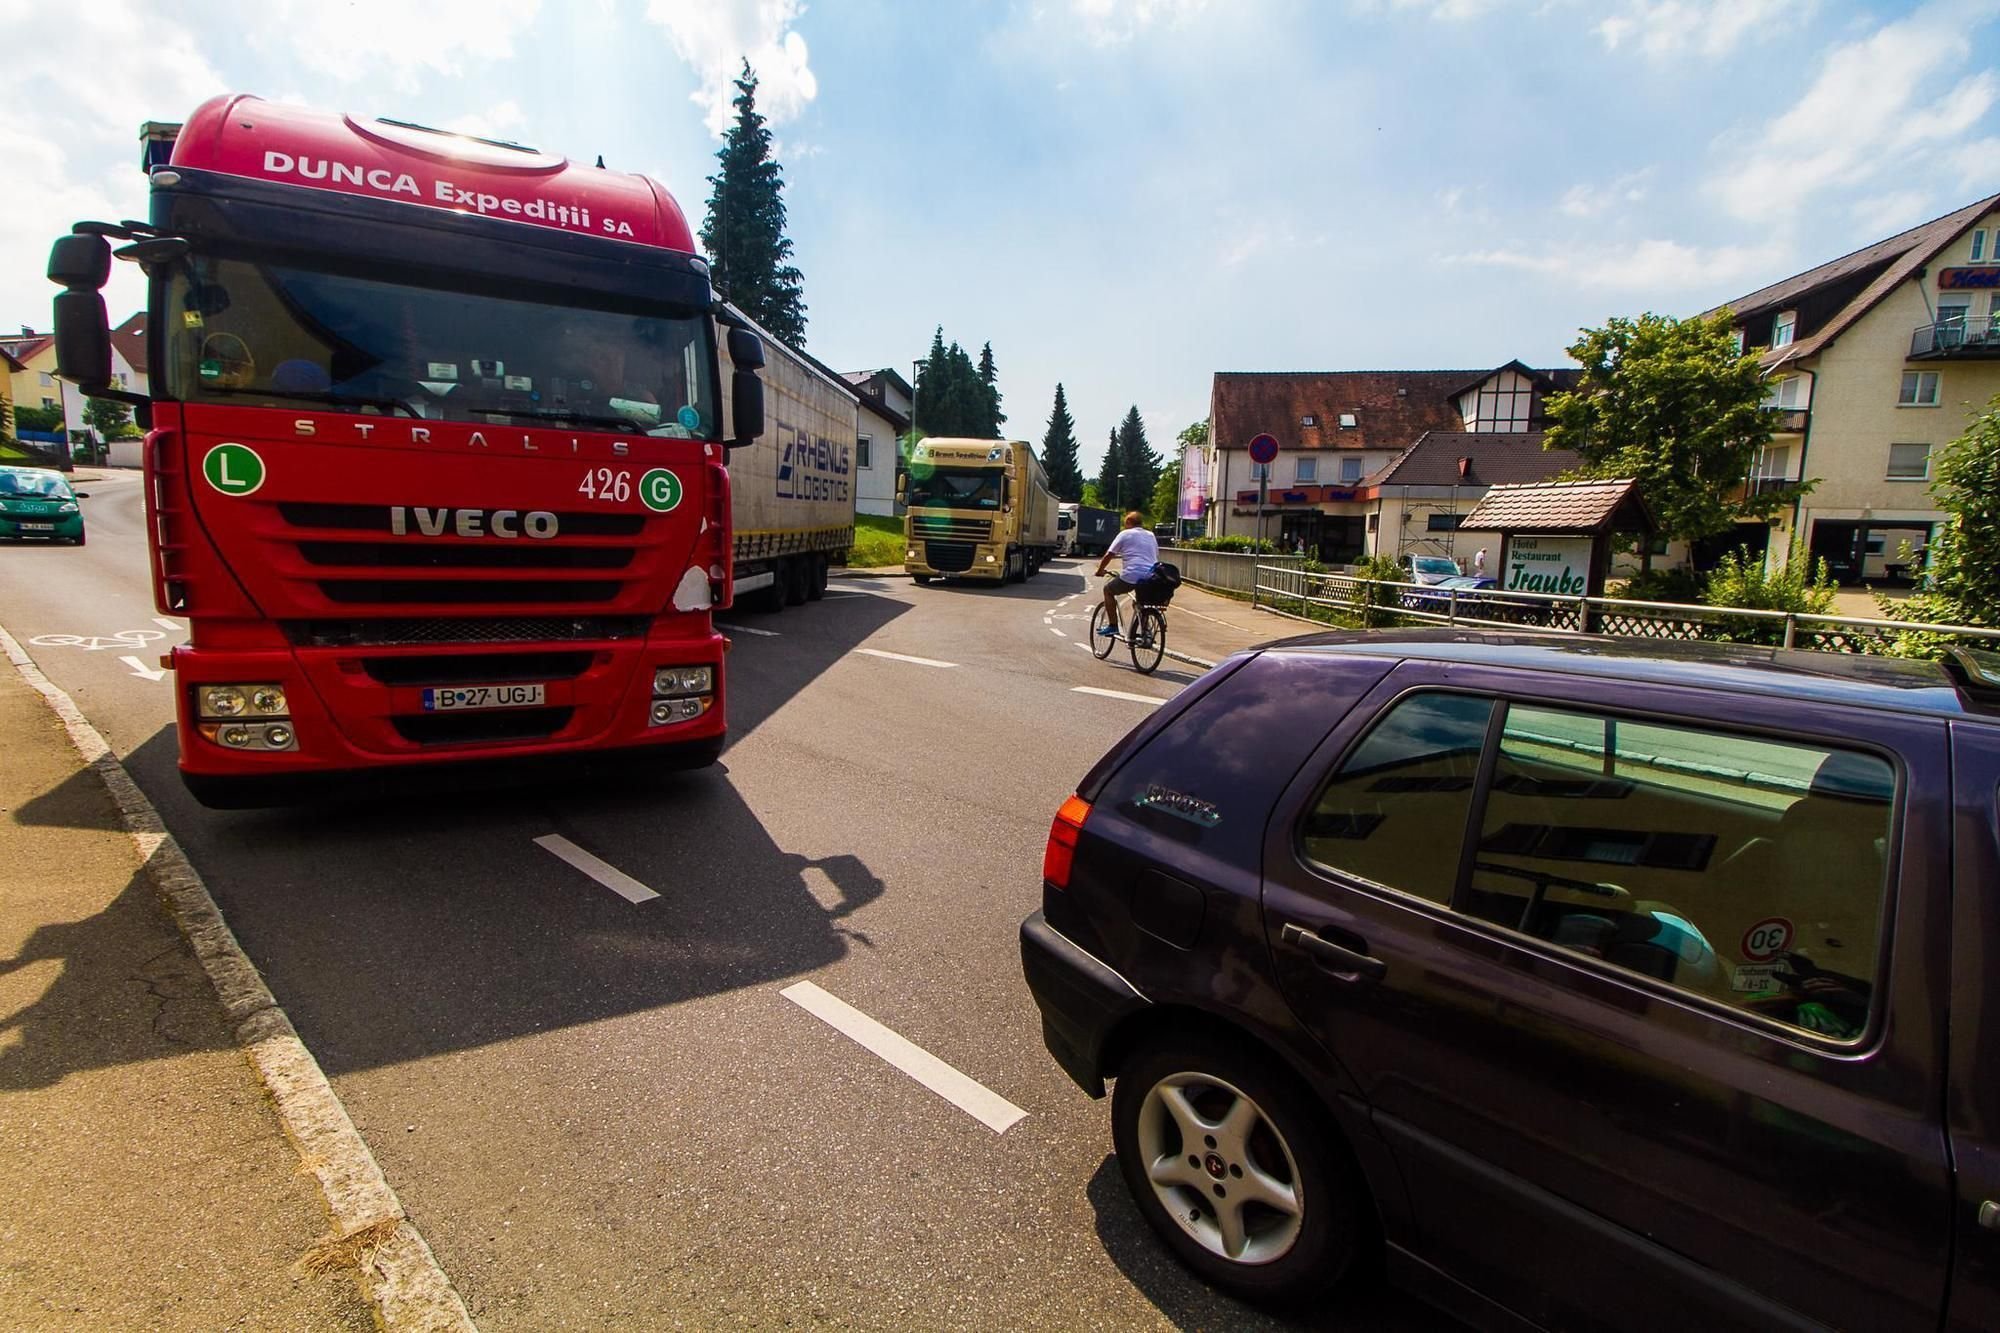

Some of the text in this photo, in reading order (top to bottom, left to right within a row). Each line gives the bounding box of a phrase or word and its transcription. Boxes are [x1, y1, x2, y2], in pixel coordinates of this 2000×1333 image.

[264, 151, 634, 237] DUNCA Expediții SA
[295, 419, 629, 456] STRALIS
[796, 431, 849, 475] RHENUS
[220, 452, 246, 486] L
[578, 468, 631, 502] 426
[650, 477, 671, 502] G
[796, 473, 849, 502] LOGISTICS
[391, 506, 559, 538] IVECO
[1511, 551, 1561, 562] Restaurant
[1512, 539, 1538, 549] Hotel
[1508, 563, 1585, 595] Traube
[441, 690, 456, 708] B
[465, 688, 488, 706] 27
[496, 686, 537, 704] UGJ
